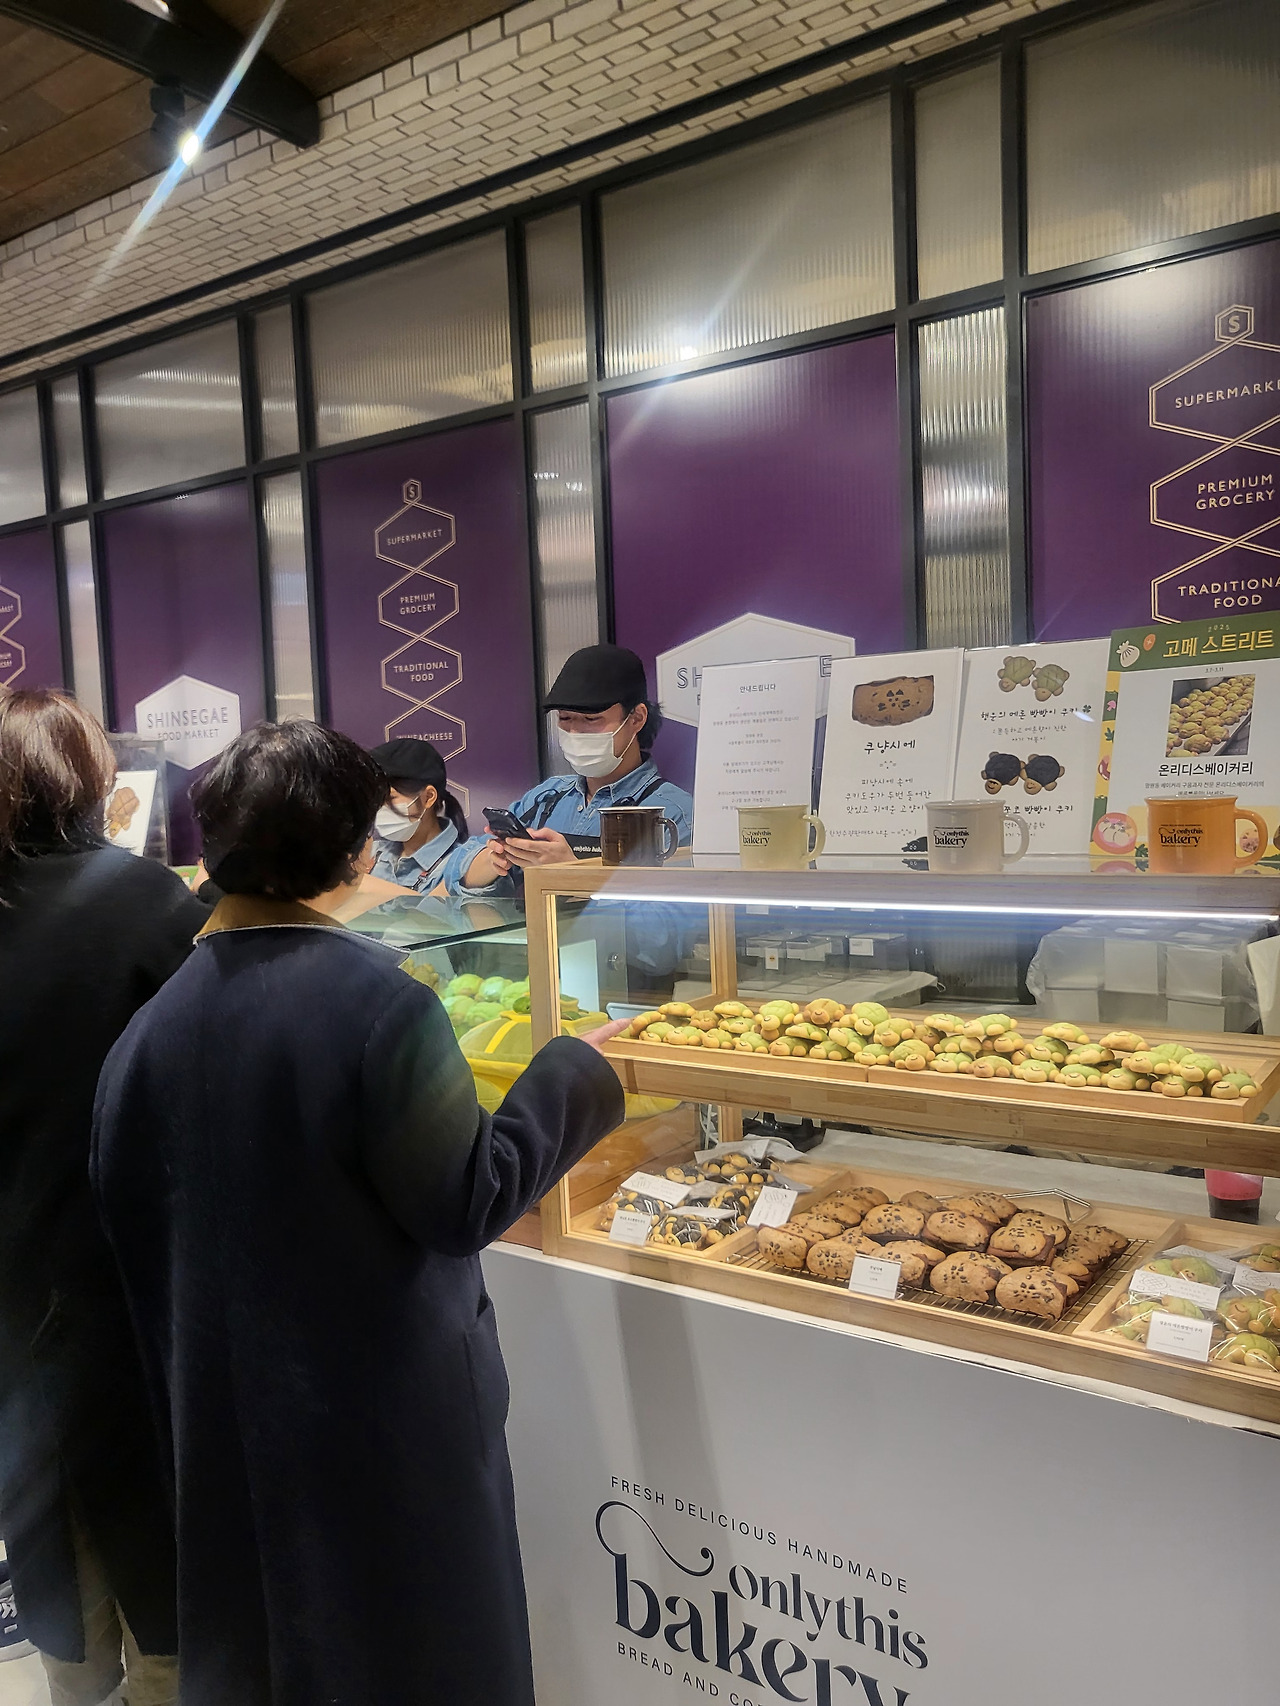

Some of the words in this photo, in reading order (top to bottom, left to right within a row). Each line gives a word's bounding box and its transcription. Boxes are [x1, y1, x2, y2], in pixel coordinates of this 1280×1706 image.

[1228, 315, 1240, 333] S
[1197, 473, 1273, 495] PREMIUM
[1195, 489, 1276, 510] GROCERY
[387, 529, 442, 546] SUPERMARKET
[400, 592, 435, 604] PREMIUM
[1213, 594, 1263, 609] FOOD
[400, 603, 436, 615] GROCERY
[1162, 636, 1198, 658] 고메
[1201, 629, 1275, 654] 스트리트
[394, 661, 449, 673] TRADITIONAL
[411, 673, 434, 682] FOOD
[739, 683, 776, 694] 안내드립니다
[147, 706, 229, 729] SHINSEGAE
[158, 731, 181, 742] FOOD
[184, 728, 219, 740] MARKET
[1158, 761, 1253, 777] 온리디스베이커리
[742, 835, 770, 845] bakery
[934, 835, 968, 847] bakery
[1159, 834, 1201, 845] bakery
[610, 1475, 665, 1506] FRESH
[674, 1498, 778, 1546] DELICIOUS
[788, 1538, 908, 1594] HANDMADE
[728, 1564, 929, 1669] onlythis
[617, 1641, 674, 1677] BREAD
[683, 1671, 720, 1697] AND
